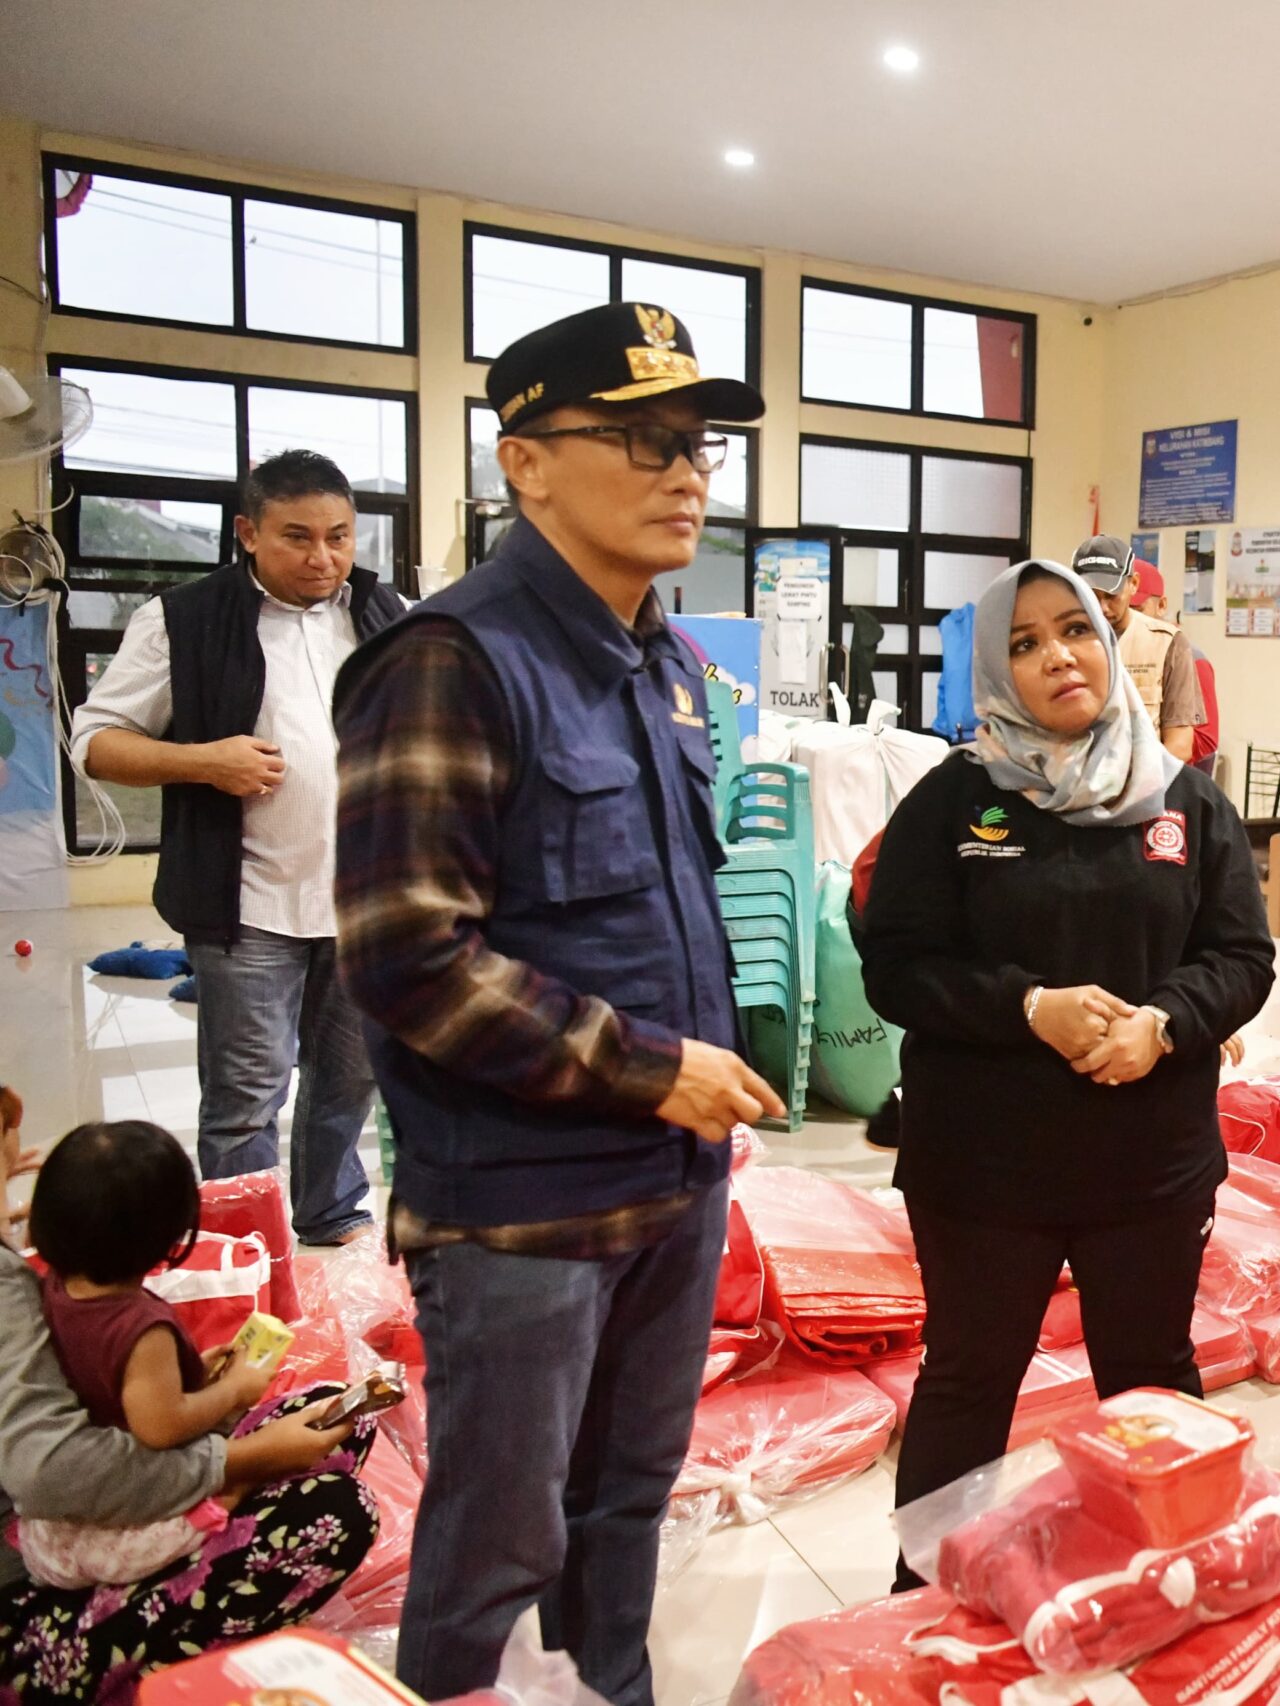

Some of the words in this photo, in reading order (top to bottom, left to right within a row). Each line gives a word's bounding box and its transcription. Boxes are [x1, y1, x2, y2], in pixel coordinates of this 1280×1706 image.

[770, 691, 820, 708] TOLAK
[814, 1018, 887, 1048] FAMILY
[1175, 1655, 1233, 1703] BANTUAN
[1229, 1622, 1268, 1661] FAMILY
